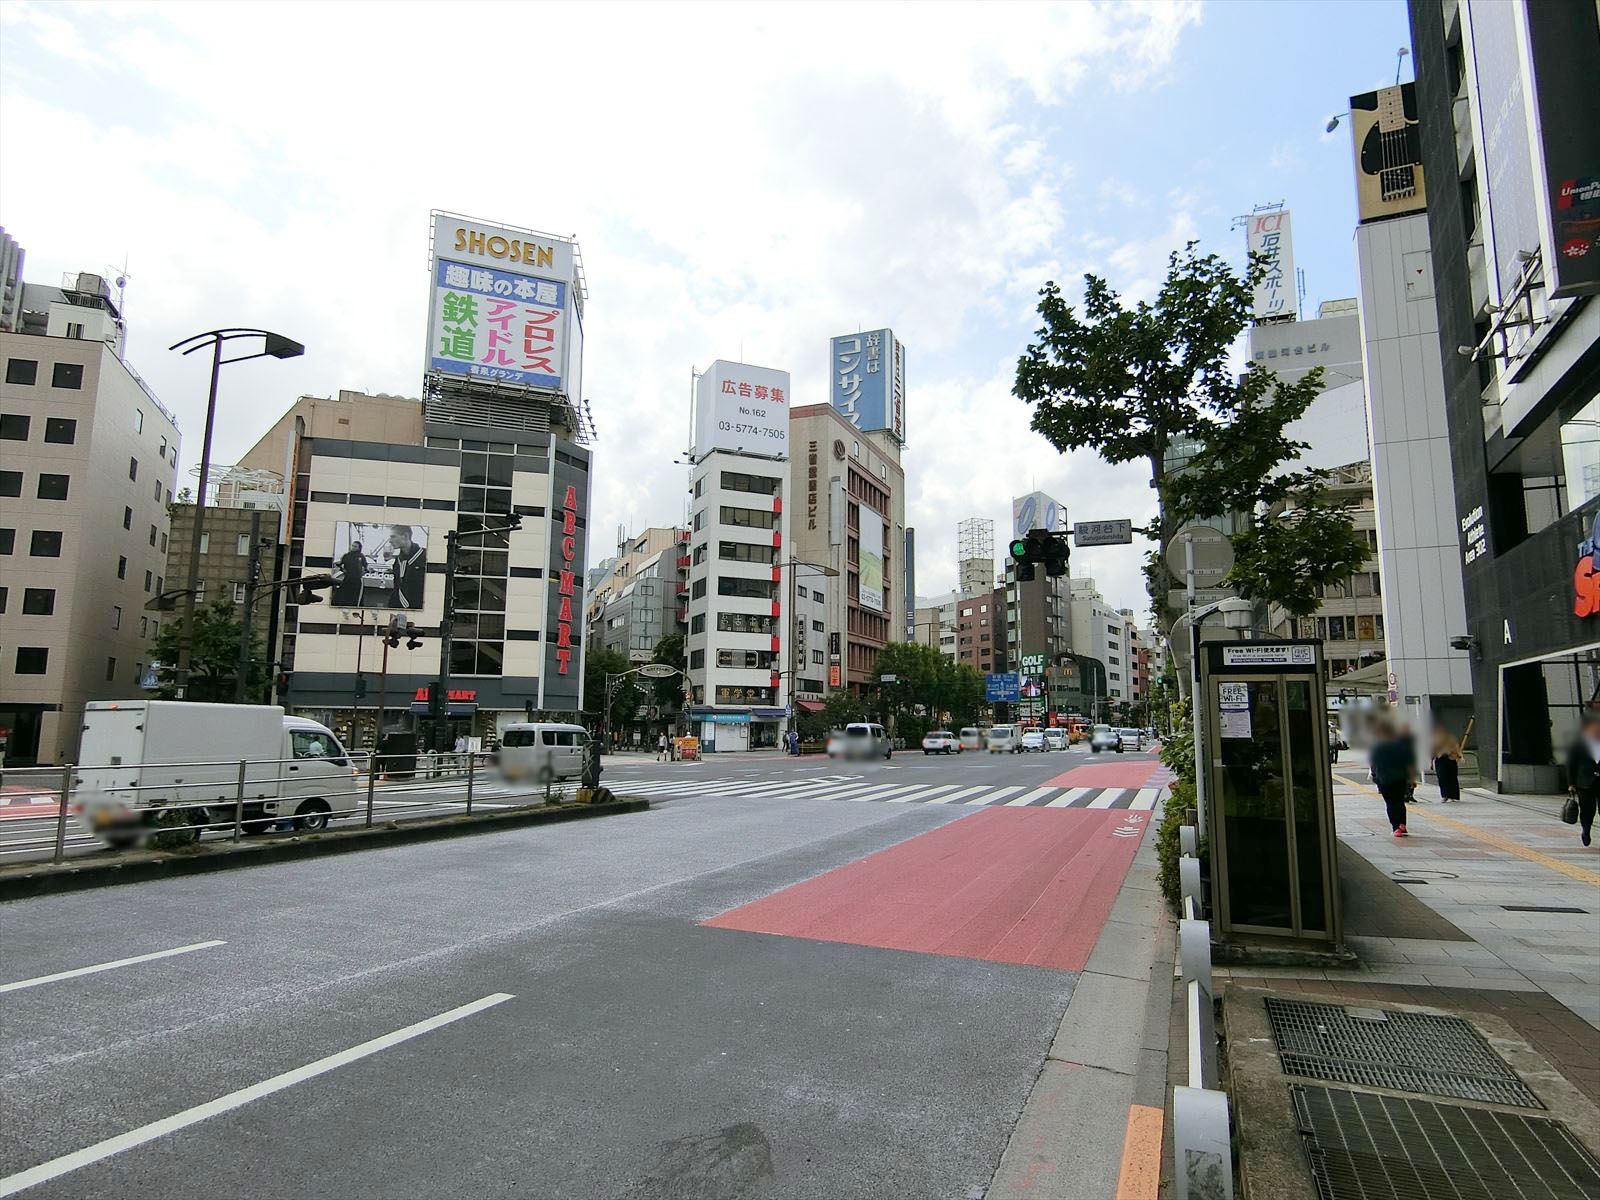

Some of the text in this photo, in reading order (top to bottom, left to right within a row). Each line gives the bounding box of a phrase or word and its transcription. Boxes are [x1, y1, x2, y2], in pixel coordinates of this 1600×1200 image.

[1253, 214, 1285, 235] ICI
[454, 228, 554, 269] SHOSEN
[445, 264, 558, 305] 趣味の本屋
[1260, 232, 1285, 314] 石井スポーツ
[439, 291, 479, 362] 鉄道
[481, 297, 518, 368] アイドル
[521, 309, 561, 374] プロレス
[721, 379, 785, 404] 広告募集
[838, 338, 863, 430] コンサイス
[738, 406, 767, 418] No.162
[718, 420, 785, 440] 03-5774-7505
[1078, 523, 1126, 535] 駿河台下
[1475, 538, 1487, 557] 302
[362, 571, 395, 580] adidas
[556, 485, 577, 675] ABC-MART
[1503, 619, 1512, 645] A
[1022, 654, 1044, 667] GOLF
[1222, 687, 1242, 695] FREE
[1223, 694, 1243, 702] Wi-Fi
